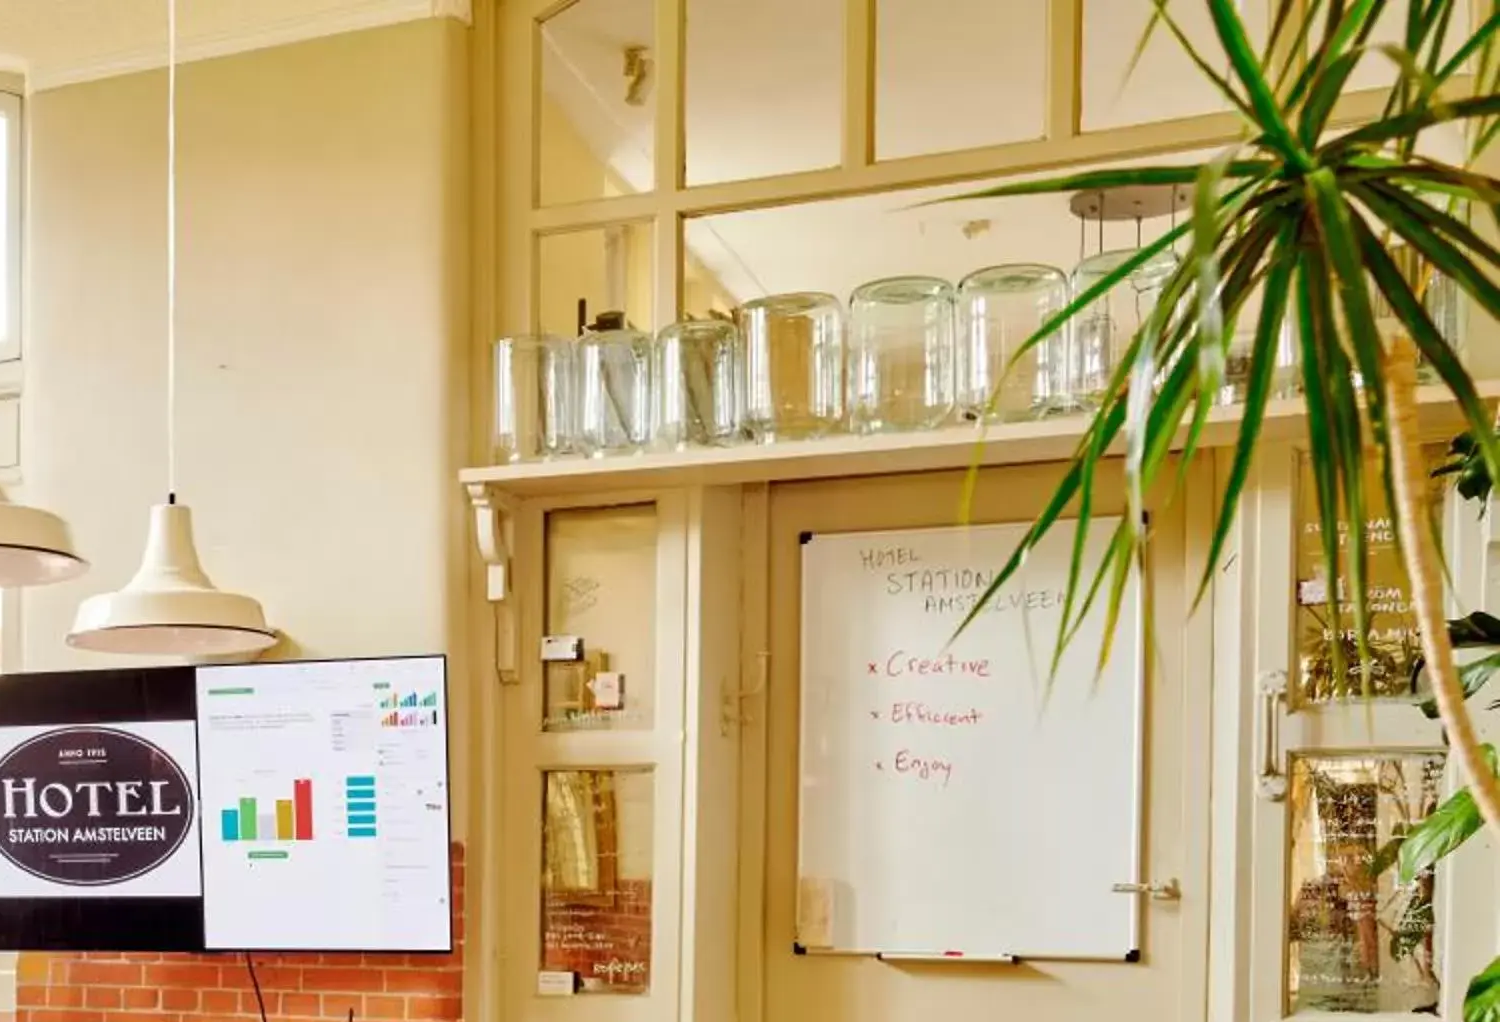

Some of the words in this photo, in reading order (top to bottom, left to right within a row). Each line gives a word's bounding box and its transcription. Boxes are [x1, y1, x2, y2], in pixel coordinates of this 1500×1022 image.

[859, 549, 919, 570] HOTEL
[887, 569, 993, 595] STATION
[924, 590, 1067, 613] AMSTLVEEN
[886, 650, 991, 677] Creative
[895, 749, 952, 787] Enjoy
[1, 777, 182, 818] HOTEL
[9, 828, 69, 844] STATION
[72, 826, 167, 842] AMSTELVEEN
